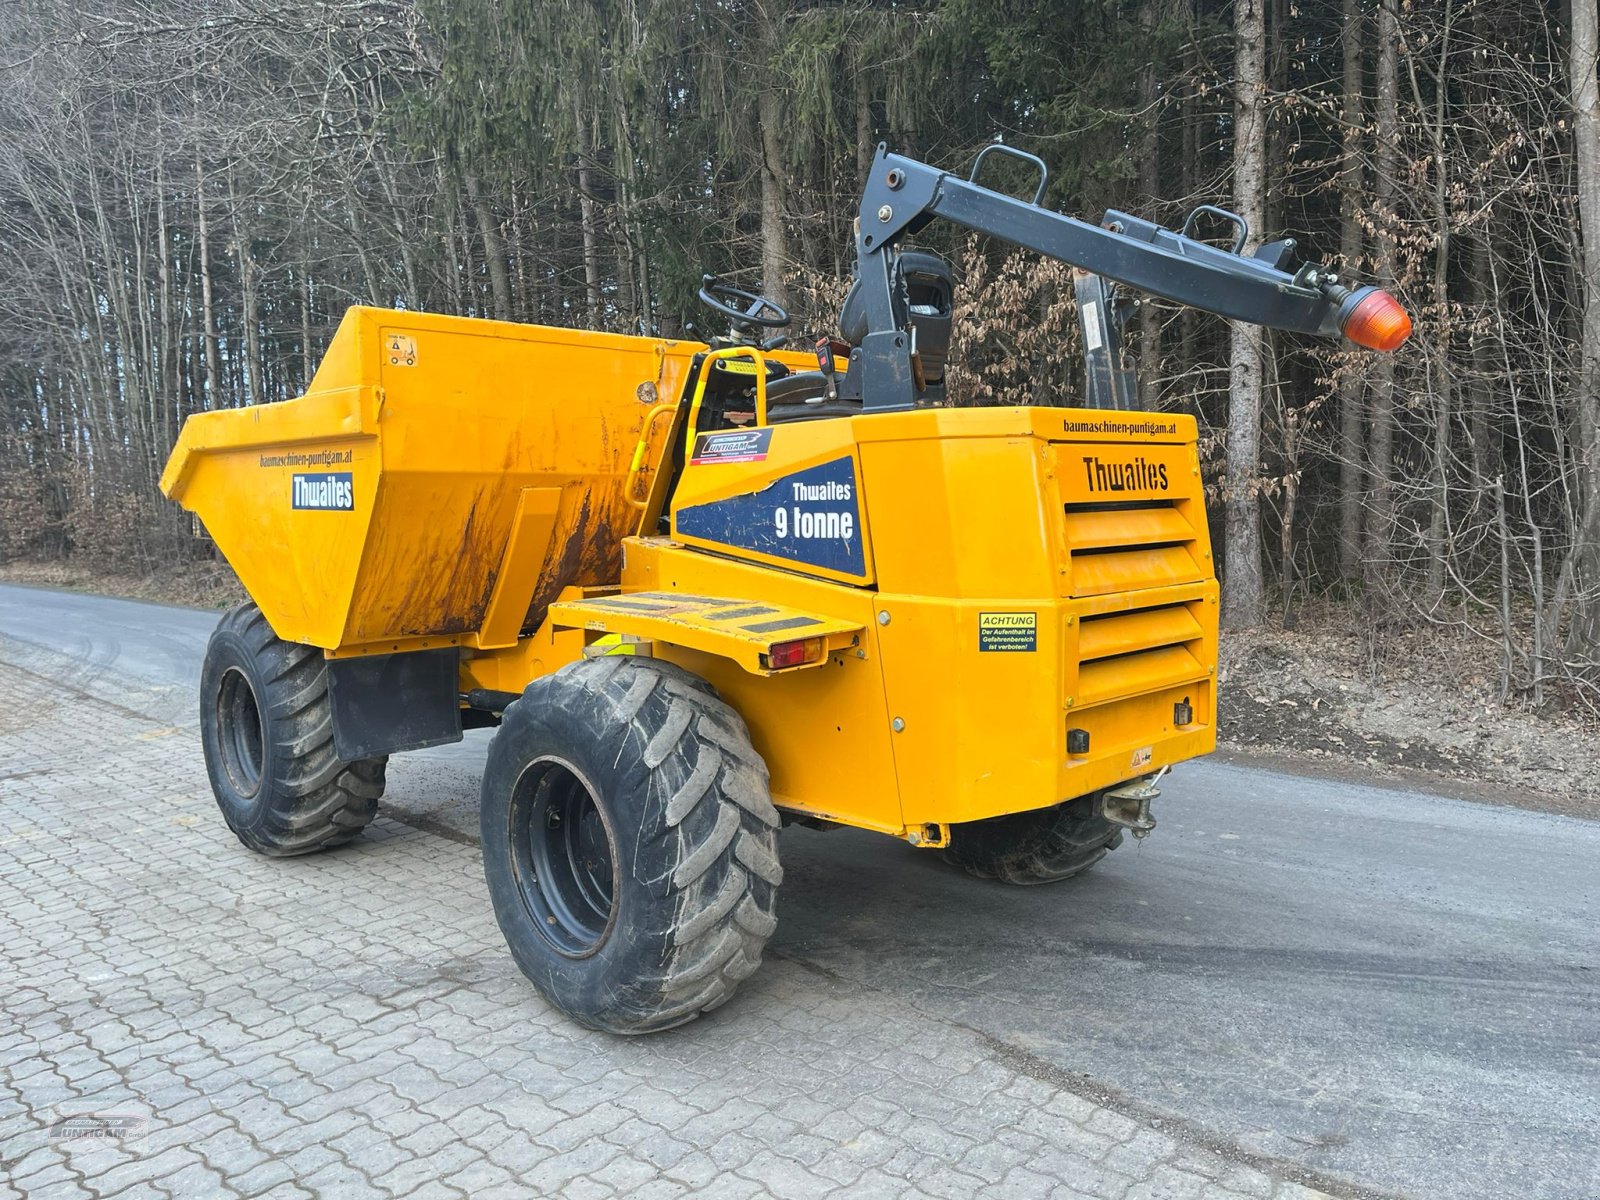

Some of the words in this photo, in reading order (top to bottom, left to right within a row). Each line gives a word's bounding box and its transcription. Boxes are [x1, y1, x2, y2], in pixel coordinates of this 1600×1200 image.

[1064, 419, 1176, 436] baumaschinen-puntigam.at
[260, 450, 352, 468] baumaschinen-puntigam.at
[1083, 457, 1168, 491] Thwaites
[294, 476, 352, 507] Thwaites
[793, 481, 851, 501] Thwaites
[775, 507, 788, 539] 9
[794, 507, 853, 539] tonne
[983, 616, 1033, 625] ACHTUNG
